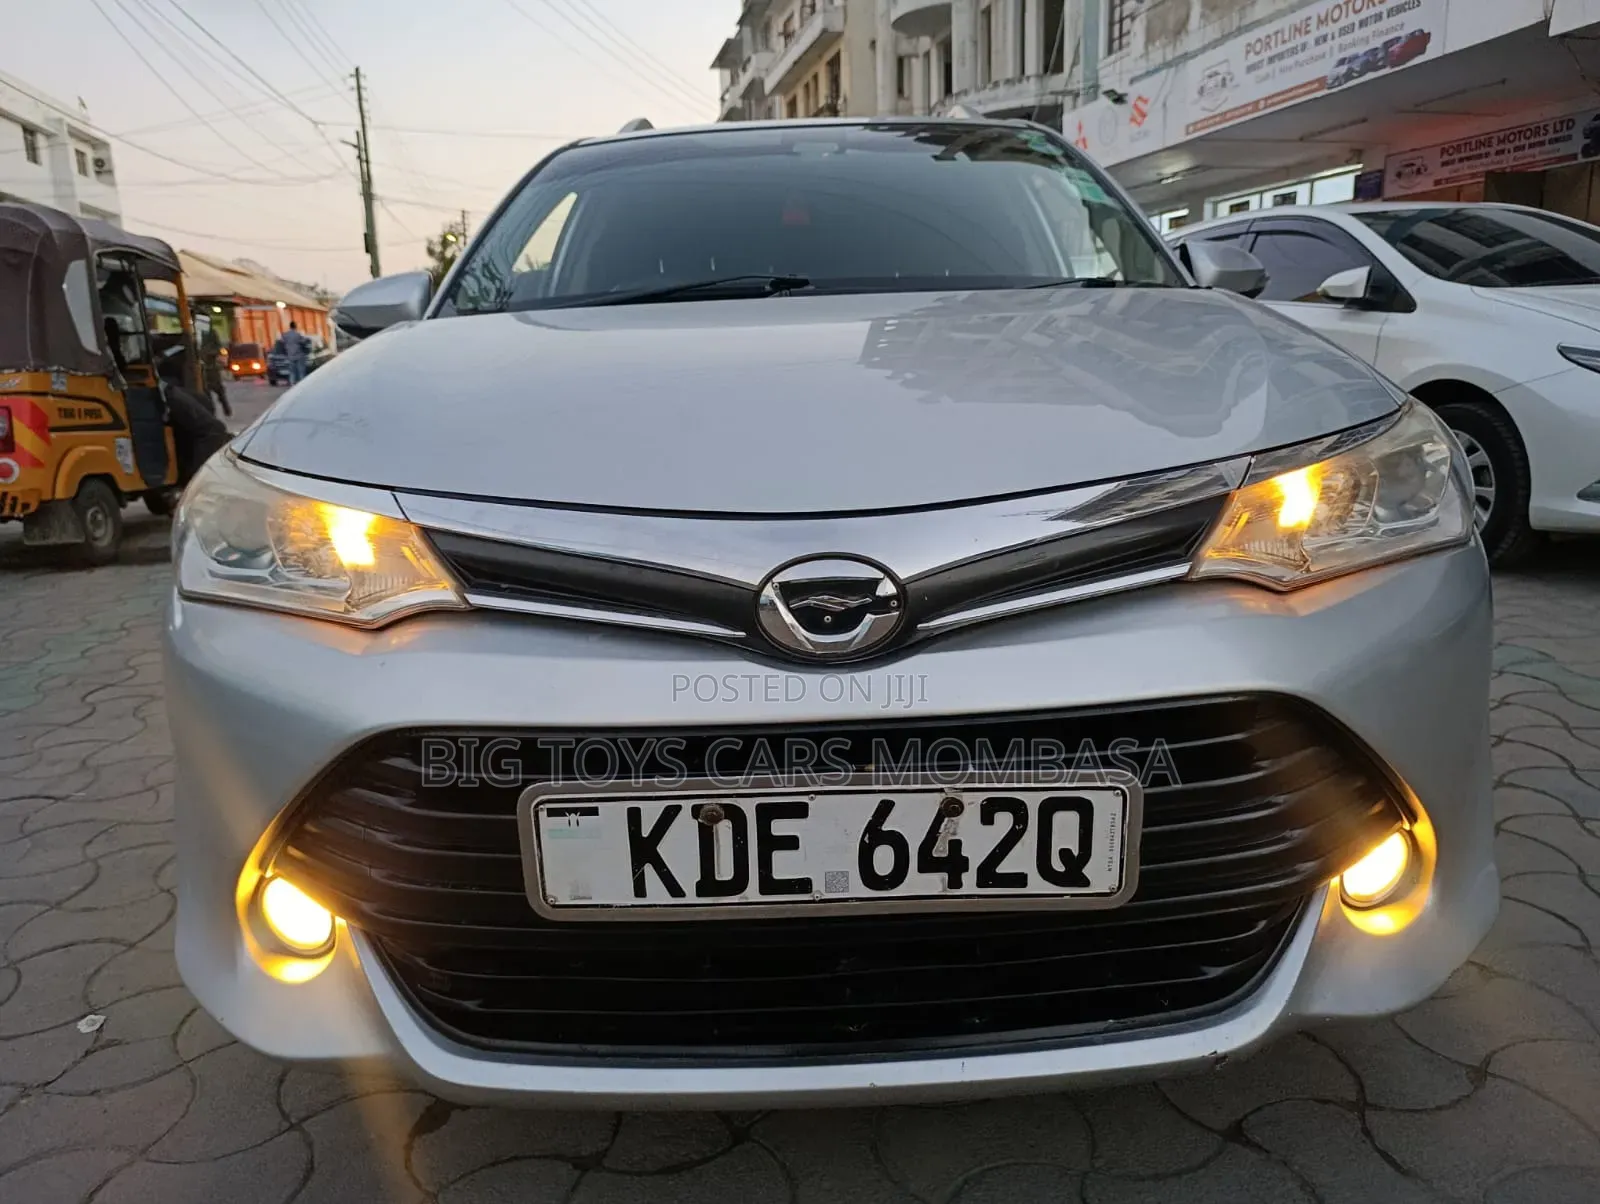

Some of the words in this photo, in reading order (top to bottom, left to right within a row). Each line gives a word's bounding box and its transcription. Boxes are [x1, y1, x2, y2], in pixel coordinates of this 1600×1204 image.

[1245, 15, 1312, 61] PORTLINE
[1315, 0, 1388, 31] MOTOR
[1440, 136, 1494, 159] PORTLINE
[1497, 124, 1549, 146] MOTORS
[1553, 118, 1576, 134] LTD
[626, 801, 814, 899] KDE
[857, 795, 1094, 891] 642Q
